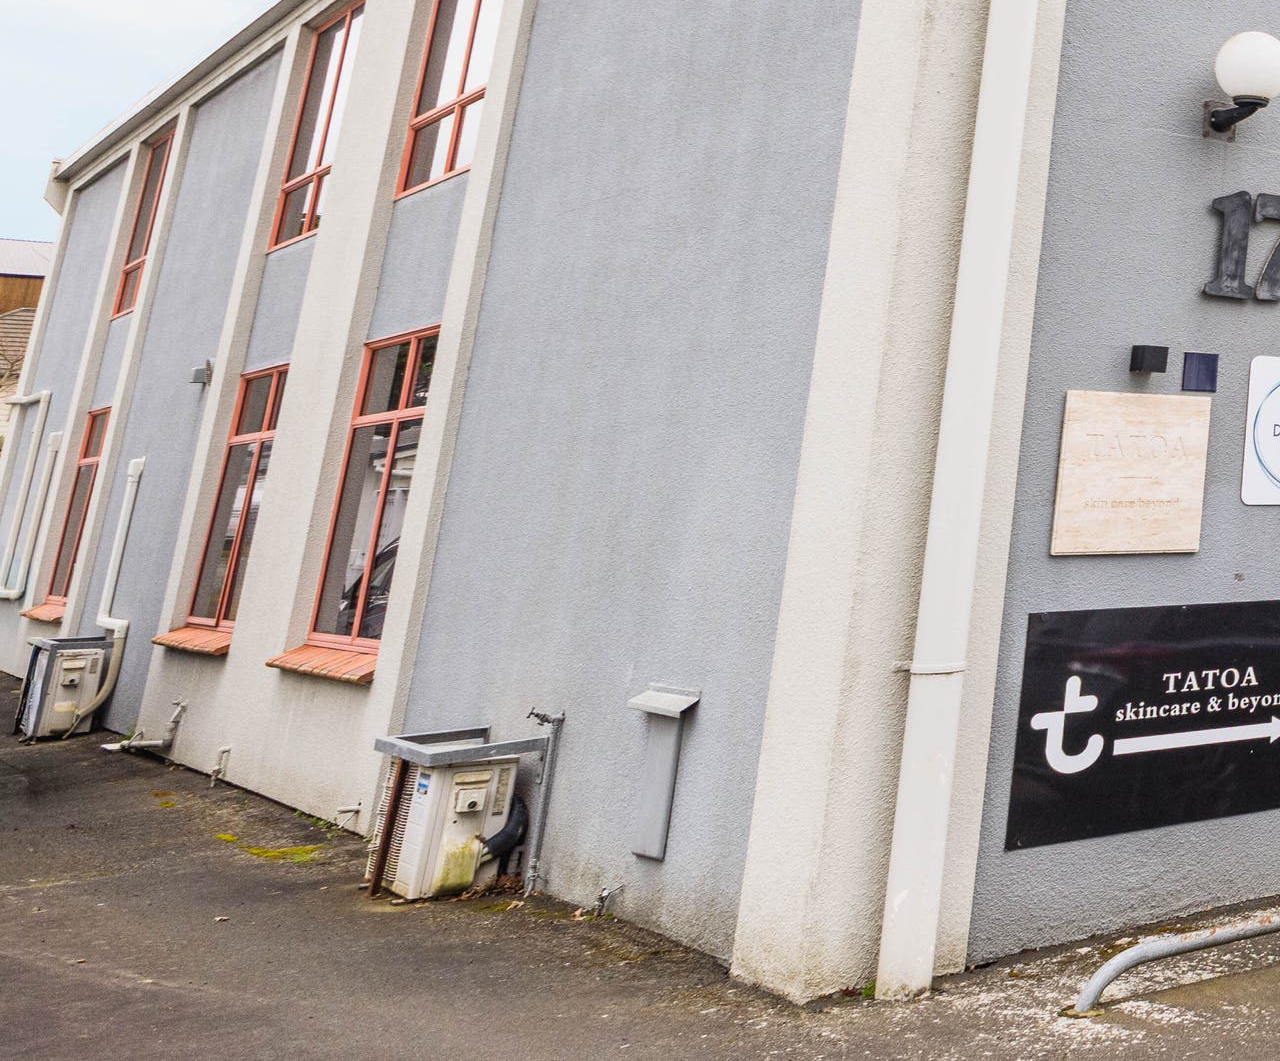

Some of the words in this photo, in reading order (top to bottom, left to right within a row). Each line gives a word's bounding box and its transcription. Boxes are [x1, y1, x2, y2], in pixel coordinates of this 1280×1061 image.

[1085, 433, 1187, 458] TATOA
[1162, 666, 1259, 694] TATOA
[1115, 700, 1200, 722] skincare
[1206, 696, 1222, 713] &
